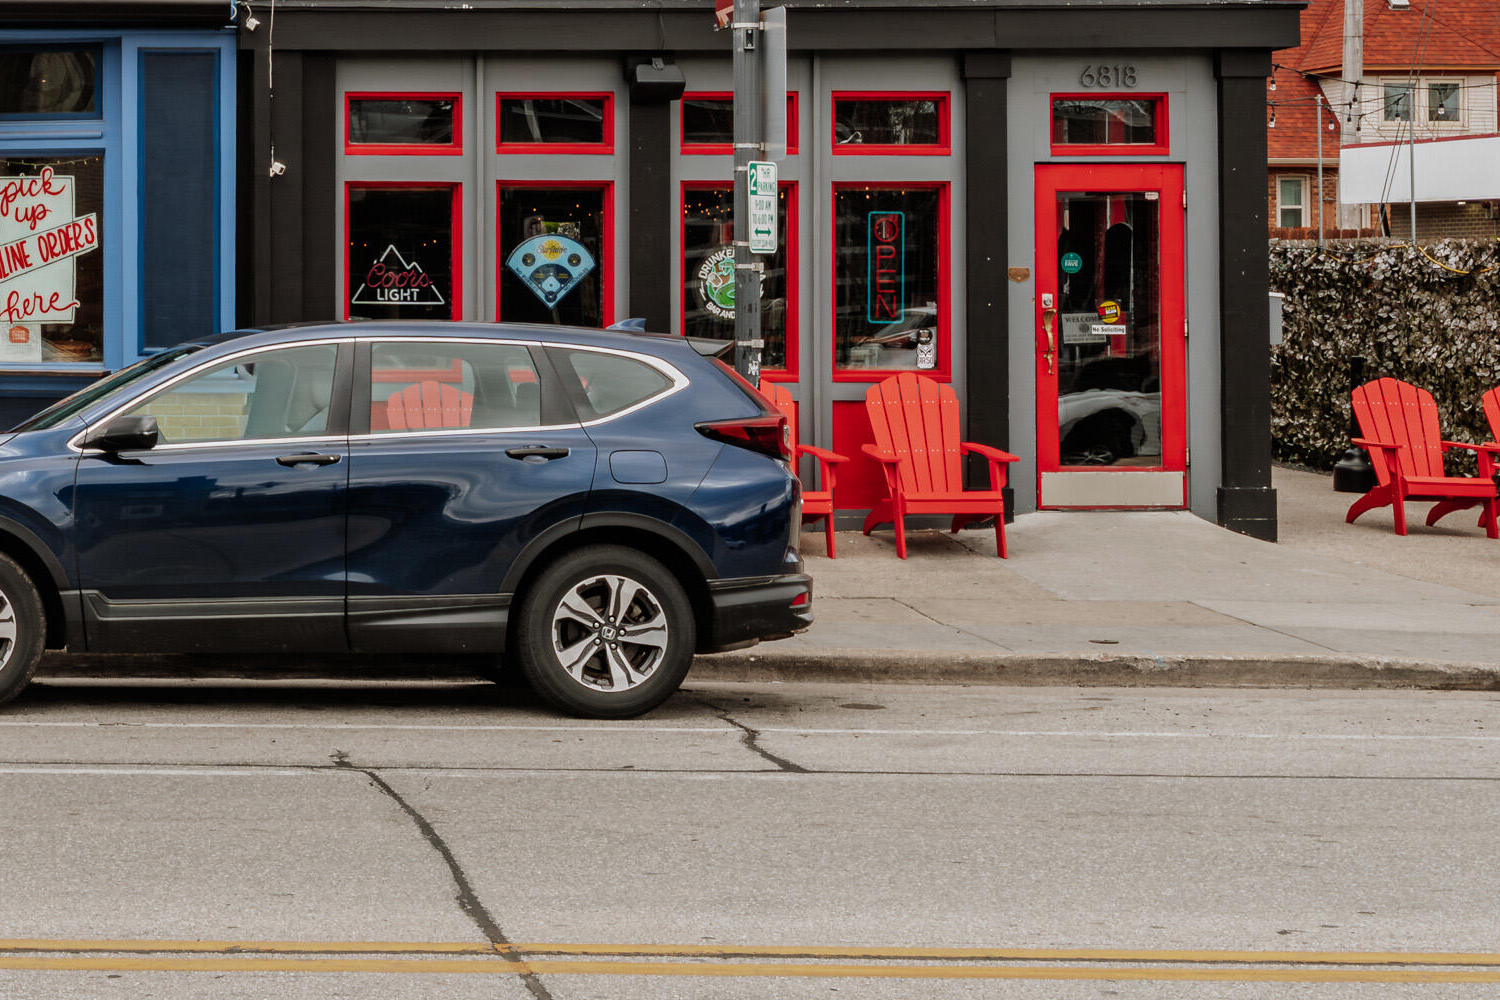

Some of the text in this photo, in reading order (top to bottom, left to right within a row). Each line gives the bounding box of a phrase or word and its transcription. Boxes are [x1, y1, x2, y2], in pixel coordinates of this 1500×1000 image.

[1079, 64, 1138, 88] 6818
[750, 168, 757, 191] 2
[757, 181, 776, 193] PARKING
[14, 203, 52, 231] up
[765, 200, 772, 211] AM
[768, 213, 774, 224] PM
[37, 218, 95, 263] ORDERS
[366, 262, 434, 288] Coors
[698, 248, 735, 280] DRUNKE
[874, 216, 899, 319] OPEN
[376, 288, 420, 301] LIGHT
[705, 301, 721, 316] BAR
[1101, 325, 1125, 334] Soliciting
